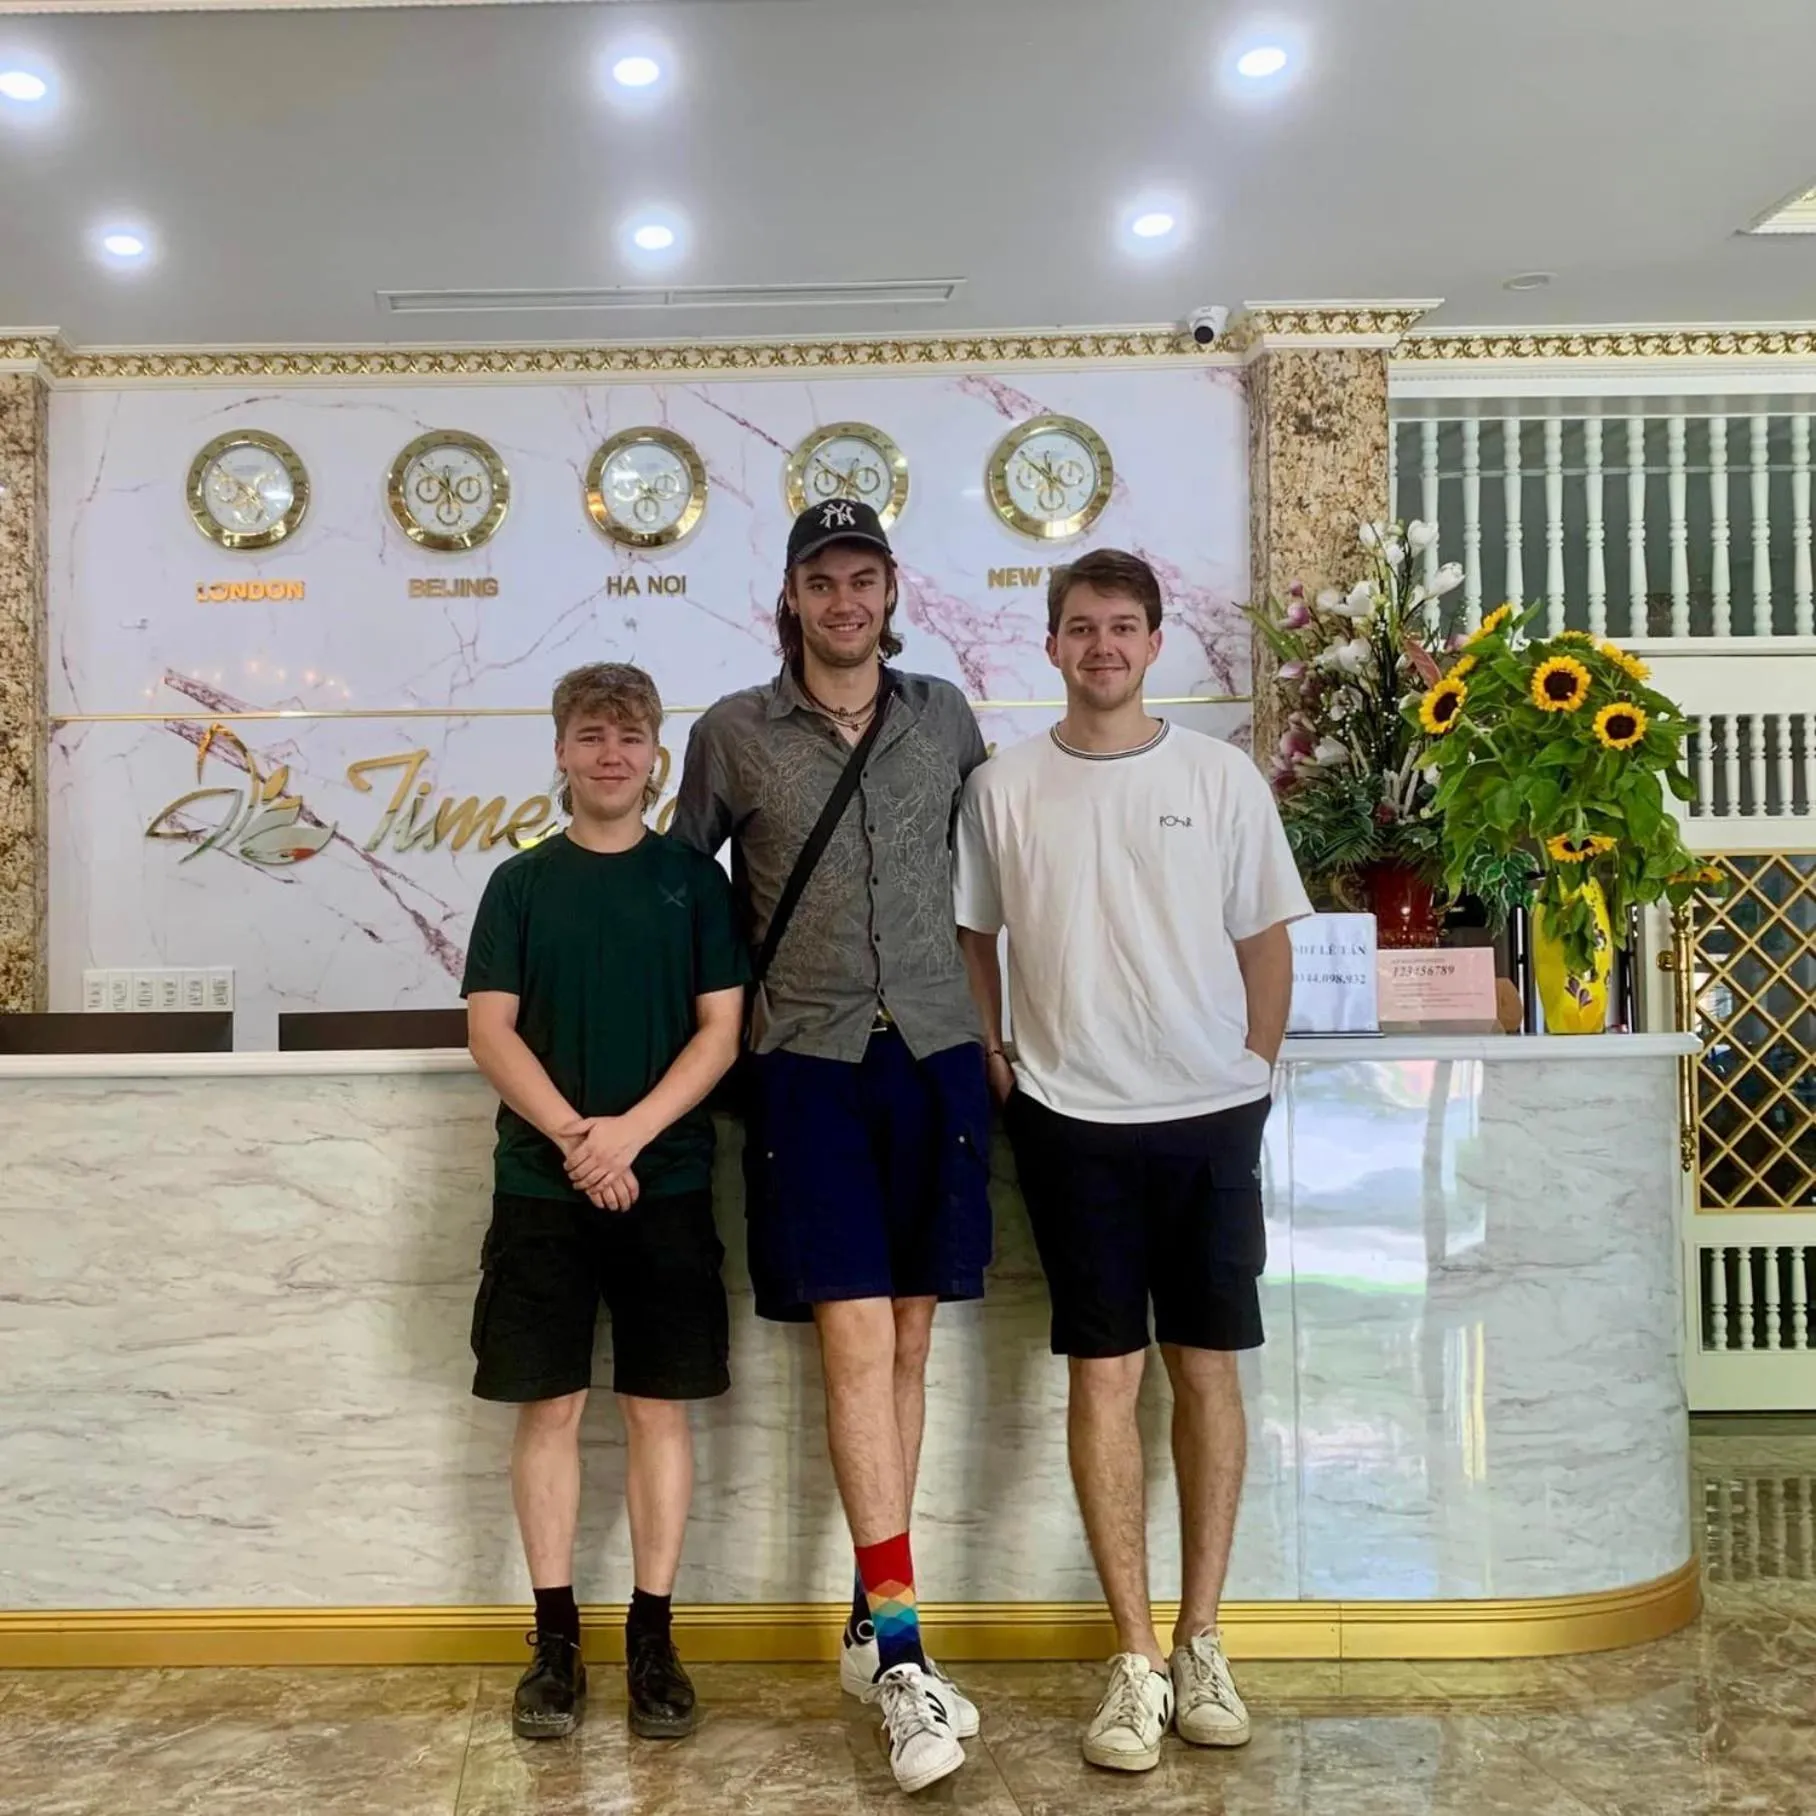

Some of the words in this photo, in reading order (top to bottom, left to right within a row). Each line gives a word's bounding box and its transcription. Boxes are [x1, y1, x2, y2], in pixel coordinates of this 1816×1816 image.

[607, 576, 640, 596] HA
[648, 575, 686, 595] NOI
[987, 567, 1042, 588] NEW
[196, 580, 305, 603] LONDON
[347, 749, 558, 852] Time
